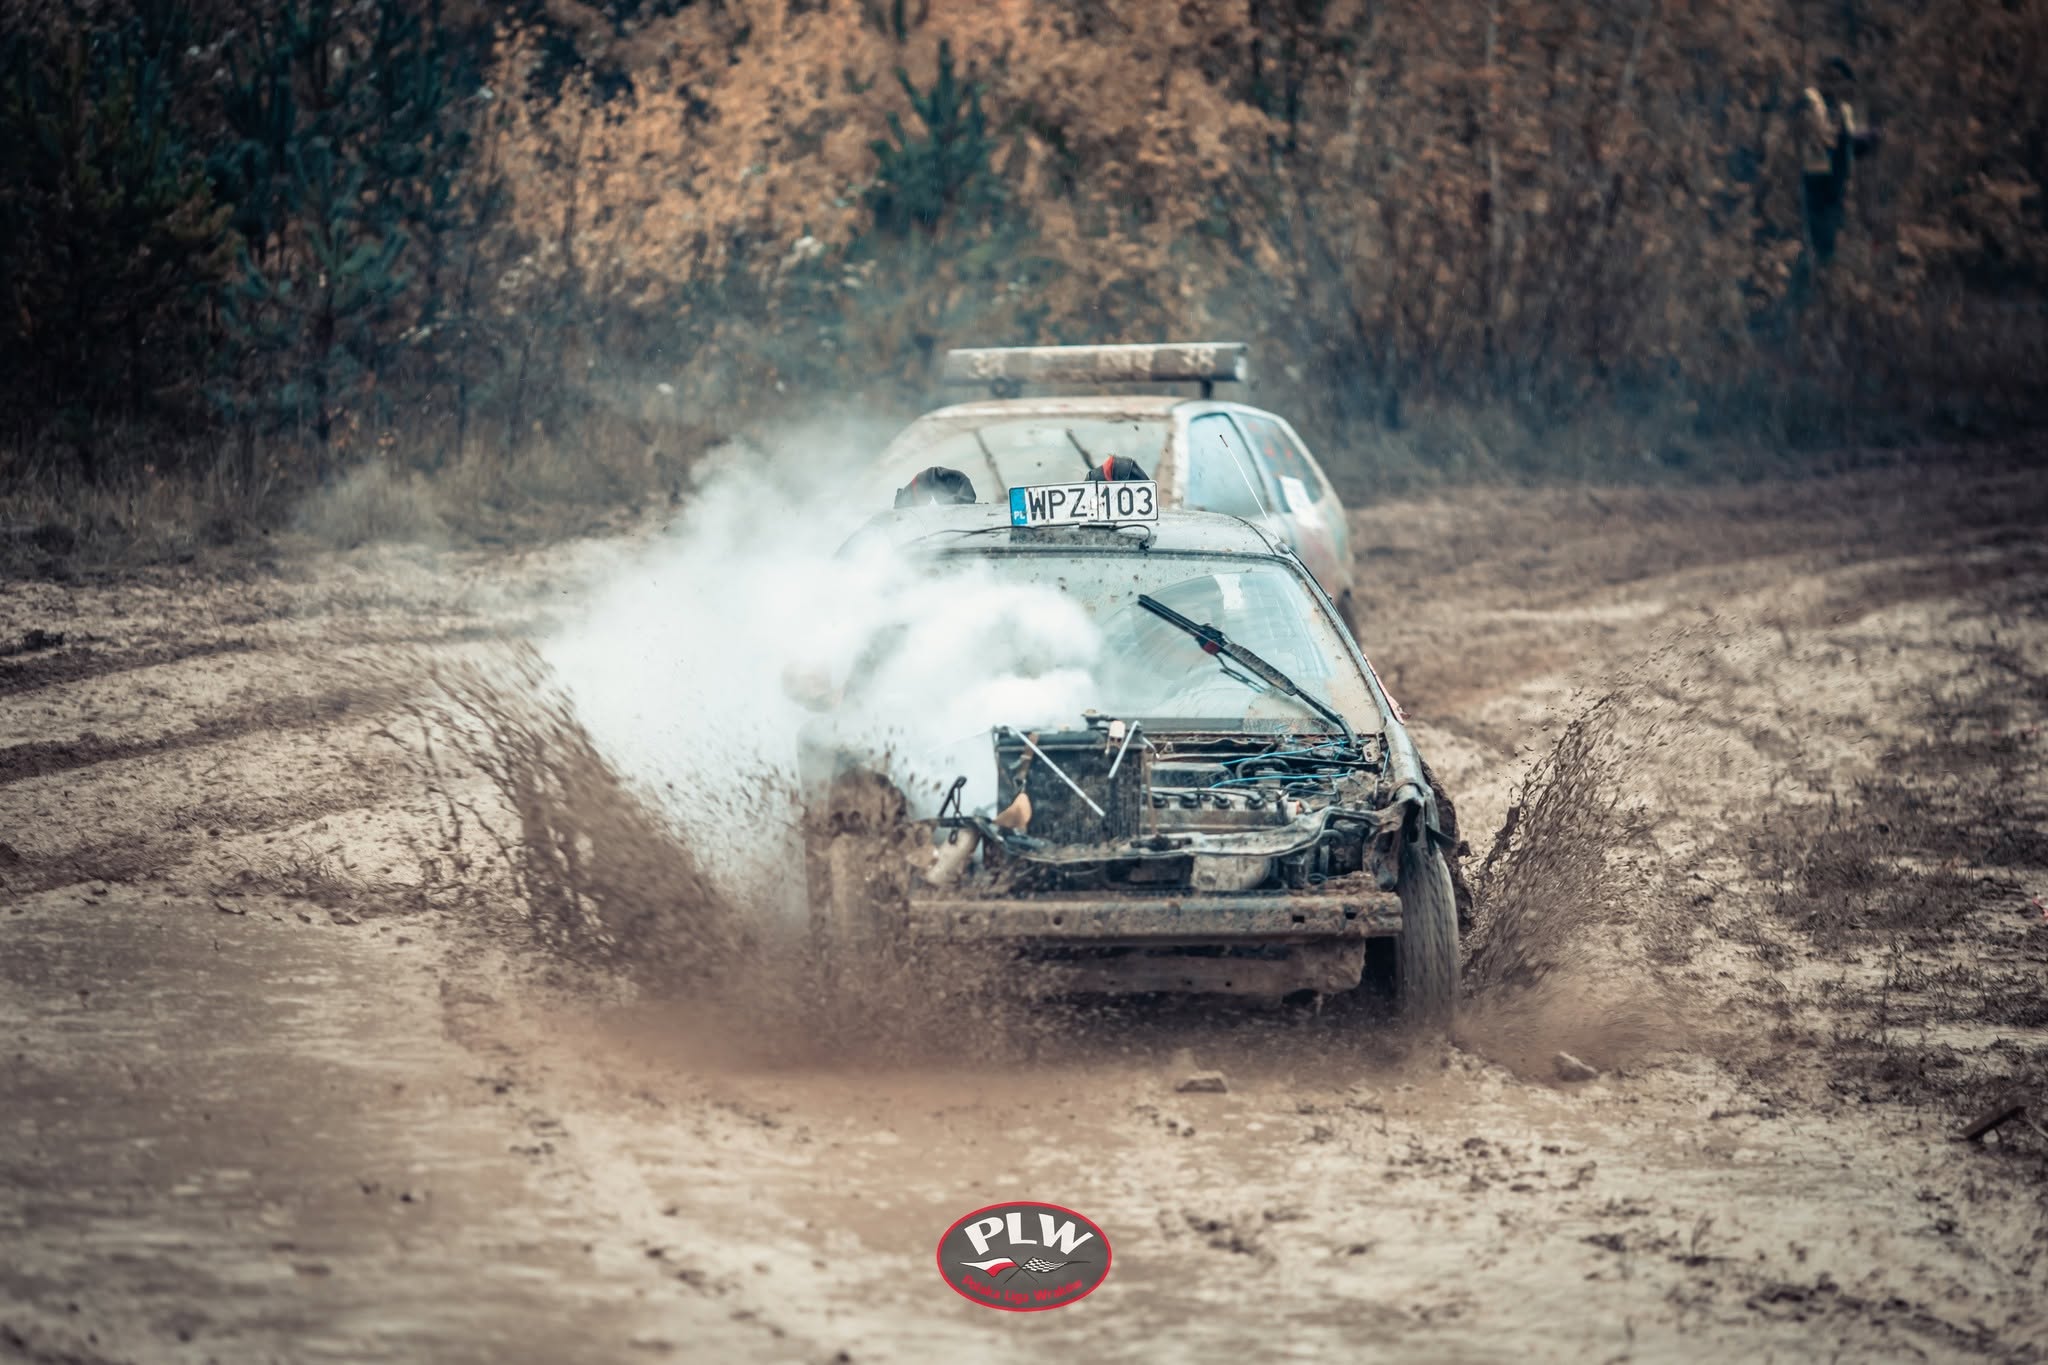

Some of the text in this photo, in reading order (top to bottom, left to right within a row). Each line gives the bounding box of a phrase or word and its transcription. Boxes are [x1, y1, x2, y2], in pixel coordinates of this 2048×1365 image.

[1028, 485, 1153, 521] WPZ 103
[1013, 510, 1027, 521] PL
